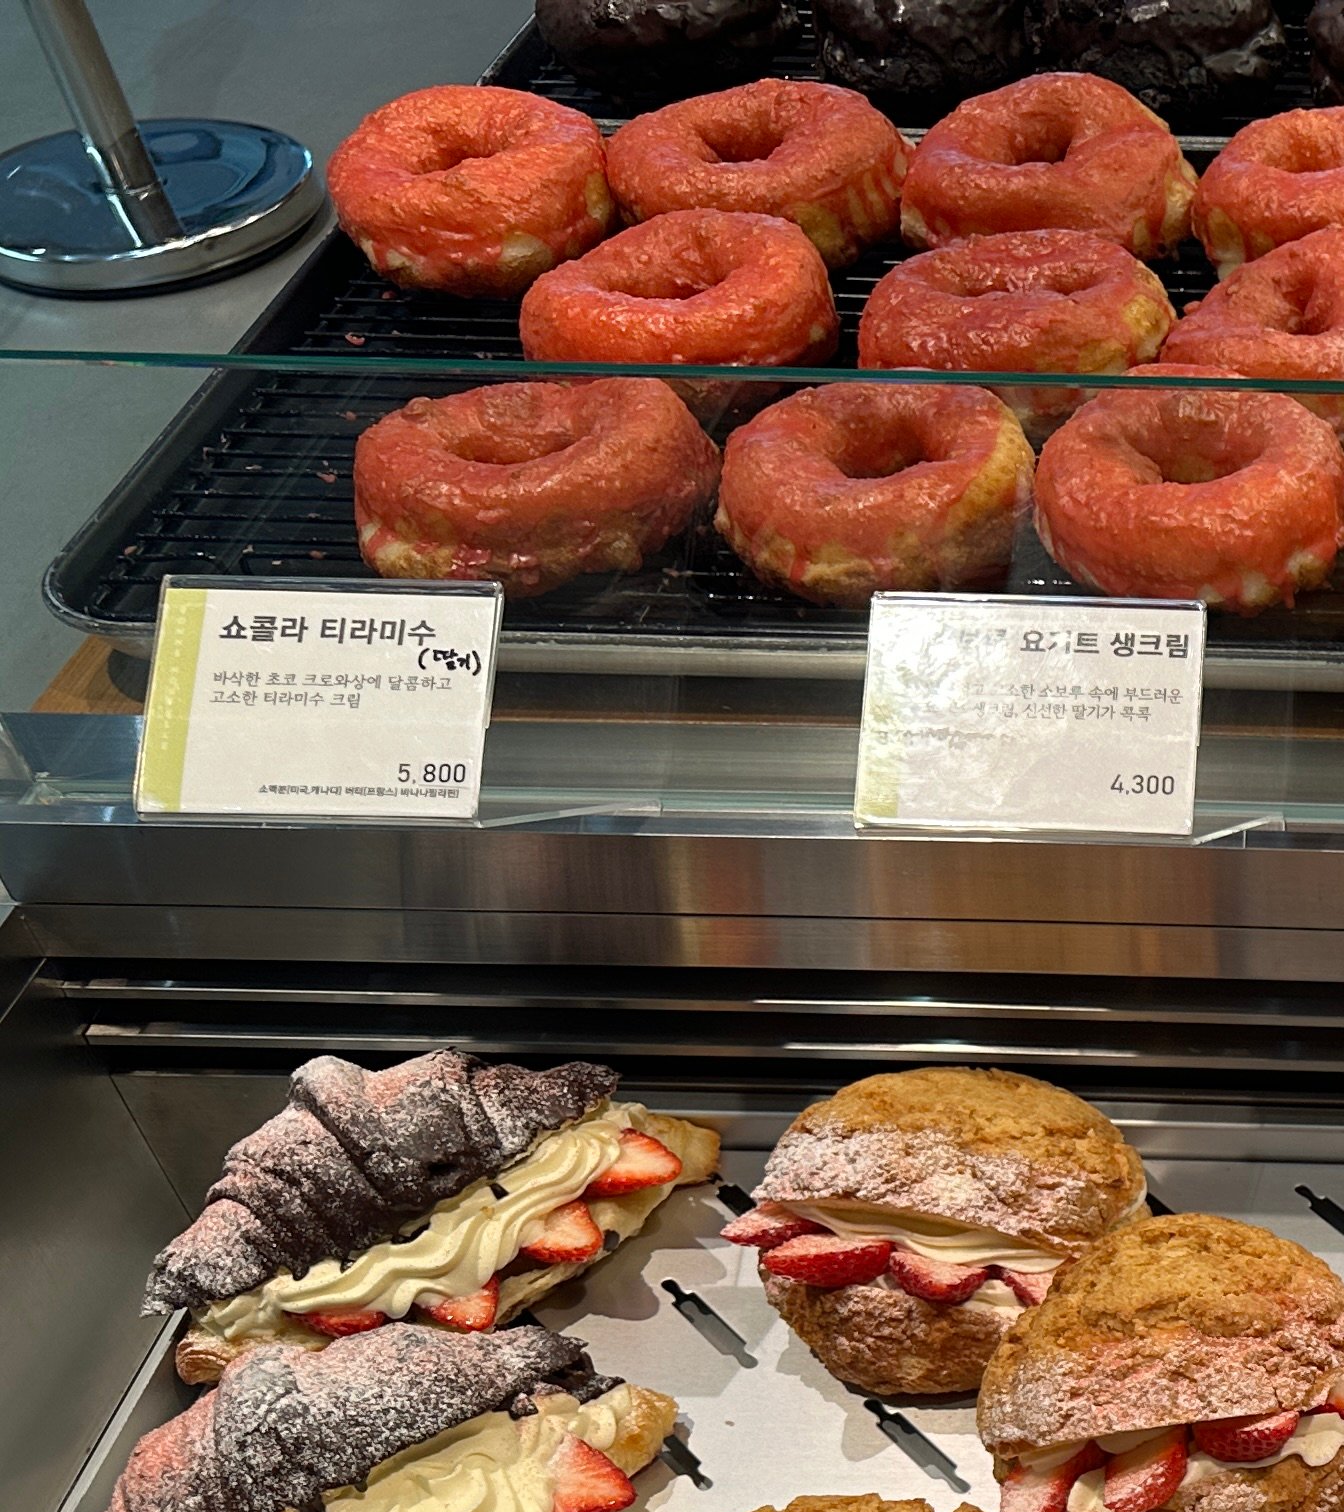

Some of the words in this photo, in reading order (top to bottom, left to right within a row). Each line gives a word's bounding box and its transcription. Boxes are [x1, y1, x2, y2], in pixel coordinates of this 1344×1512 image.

[218, 614, 309, 643] 쇼콜라
[319, 616, 437, 647] 티라미수
[1109, 632, 1190, 659] 생크림
[213, 671, 261, 688] 바삭한
[264, 673, 298, 688] 초코
[302, 674, 382, 690] 크로와상에
[387, 675, 452, 692] 달콤하고
[208, 690, 258, 706] 고소한
[263, 691, 325, 707] 티라미수
[329, 693, 361, 709] 크림
[1088, 685, 1119, 701] 속에
[1124, 687, 1184, 705] 부드러운
[1024, 703, 1067, 720] 신선한
[1071, 704, 1117, 721] 딸기가
[1110, 774, 1175, 797] 4,300
